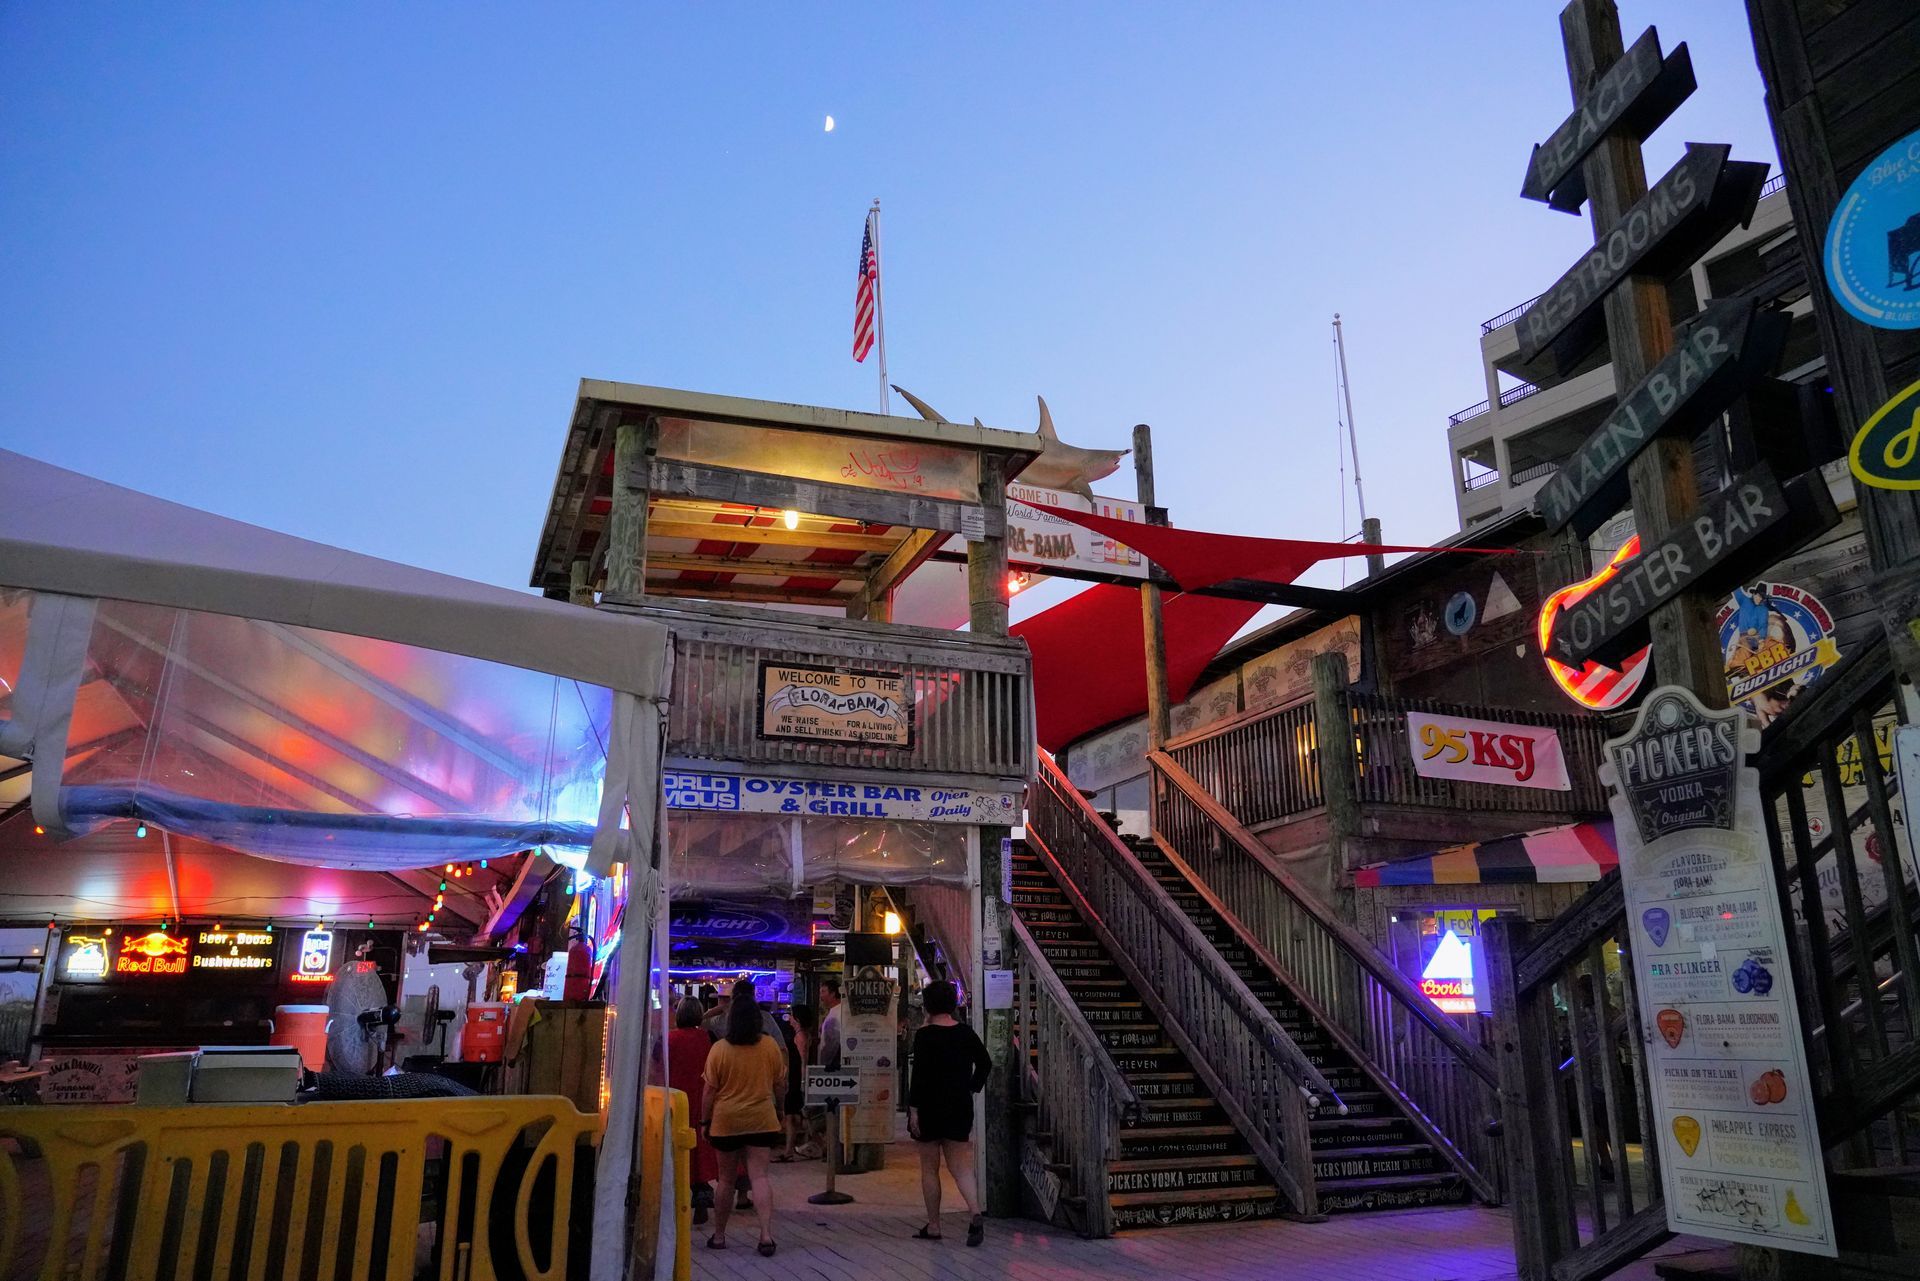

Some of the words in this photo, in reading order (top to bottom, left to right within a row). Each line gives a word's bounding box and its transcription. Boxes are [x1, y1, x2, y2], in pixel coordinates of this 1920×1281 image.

[1541, 52, 1642, 179] BEACH
[1528, 165, 1696, 341] RESTROOMS
[1549, 405, 1645, 523] MAIN
[1648, 325, 1728, 416] BAR
[1045, 492, 1058, 505] TO
[1569, 543, 1692, 650] OYSTER
[1694, 484, 1773, 560] BAR
[1744, 643, 1791, 677] PBR
[779, 670, 840, 687] WELCOME
[850, 676, 866, 689] TO
[876, 679, 898, 692] THE
[1731, 673, 1767, 699] BUD
[1768, 648, 1815, 680] LIGHT
[781, 715, 793, 723] WE
[796, 717, 819, 726] RAISE
[847, 720, 860, 728] FOR
[868, 722, 892, 731] LIVING
[776, 725, 791, 733] AND
[794, 726, 813, 735] SELL
[849, 730, 857, 738] AS
[865, 731, 898, 741] SIDELINE
[1620, 722, 1736, 788] PICKERS
[745, 779, 857, 800] OYSTER
[864, 785, 922, 801] BAR
[930, 791, 970, 802] Open
[1659, 782, 1704, 803] VODKA
[780, 799, 800, 812] &
[809, 800, 889, 818] GRILL
[929, 804, 972, 819] Daily
[1661, 805, 1708, 825] Original
[1671, 853, 1713, 869] FLAVORED
[1674, 874, 1713, 891] FLORA-BAMA
[1680, 905, 1714, 920] BLUEBERRY
[230, 946, 239, 956] &
[116, 957, 150, 973] Red
[152, 956, 186, 973] Bull
[192, 955, 273, 969] Bushwackers
[1673, 960, 1722, 975] SLINGER
[848, 980, 892, 996] PICKERS
[1421, 979, 1463, 995] Coors
[1696, 1013, 1736, 1026] FLORA-BAMA
[1738, 1012, 1780, 1026] BLOODHOUND
[49, 1062, 70, 1076] JACK
[1690, 1069, 1702, 1078] ON
[1702, 1069, 1718, 1078] THE
[1719, 1070, 1738, 1079] LINE
[808, 1078, 840, 1087] FOOD
[1712, 1119, 1754, 1136] PINEAPPLE
[1758, 1122, 1797, 1139] EXPRESS
[1341, 1134, 1361, 1142] CORN
[1341, 1160, 1371, 1176] VODKA
[1717, 1153, 1755, 1166] VODKA
[1758, 1157, 1766, 1167] &
[1769, 1158, 1801, 1170] SODA
[1108, 1173, 1150, 1191] PICKERS
[1152, 1171, 1184, 1189] VODKA
[1221, 1171, 1231, 1182] ON
